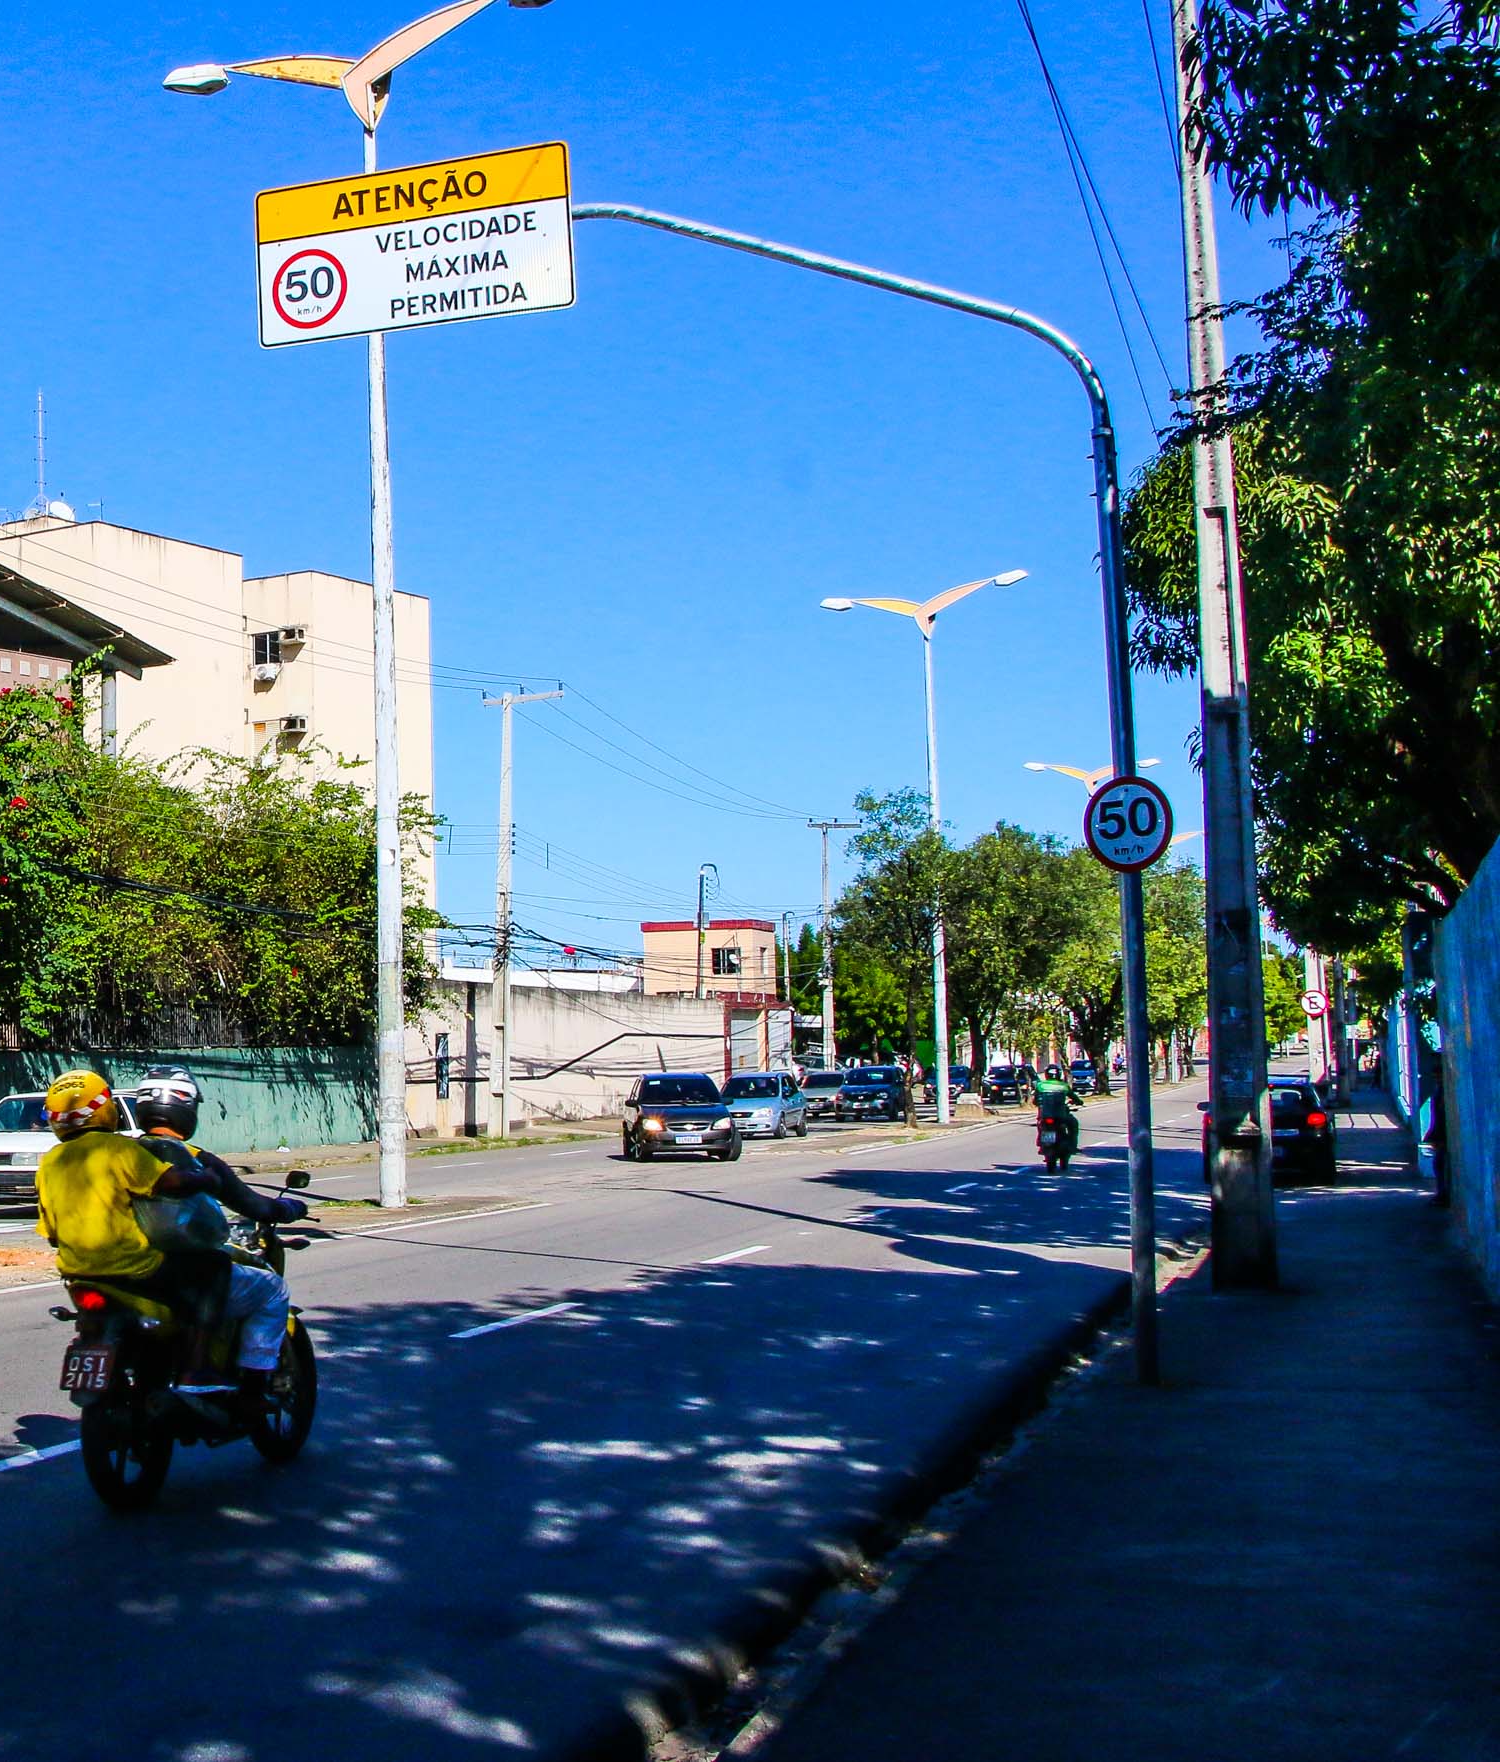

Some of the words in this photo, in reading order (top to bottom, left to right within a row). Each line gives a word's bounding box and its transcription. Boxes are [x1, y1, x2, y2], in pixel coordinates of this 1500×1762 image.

[332, 169, 487, 220] ATENÇÃO
[375, 210, 537, 253] VELOCIDADE
[285, 266, 334, 303] 50
[405, 250, 508, 283] MÁXIMA
[297, 305, 322, 316] km/h
[390, 282, 528, 319] PERMITIDA
[1098, 796, 1157, 840] 50
[1113, 844, 1144, 856] km/h
[65, 1372, 105, 1389] 2115
